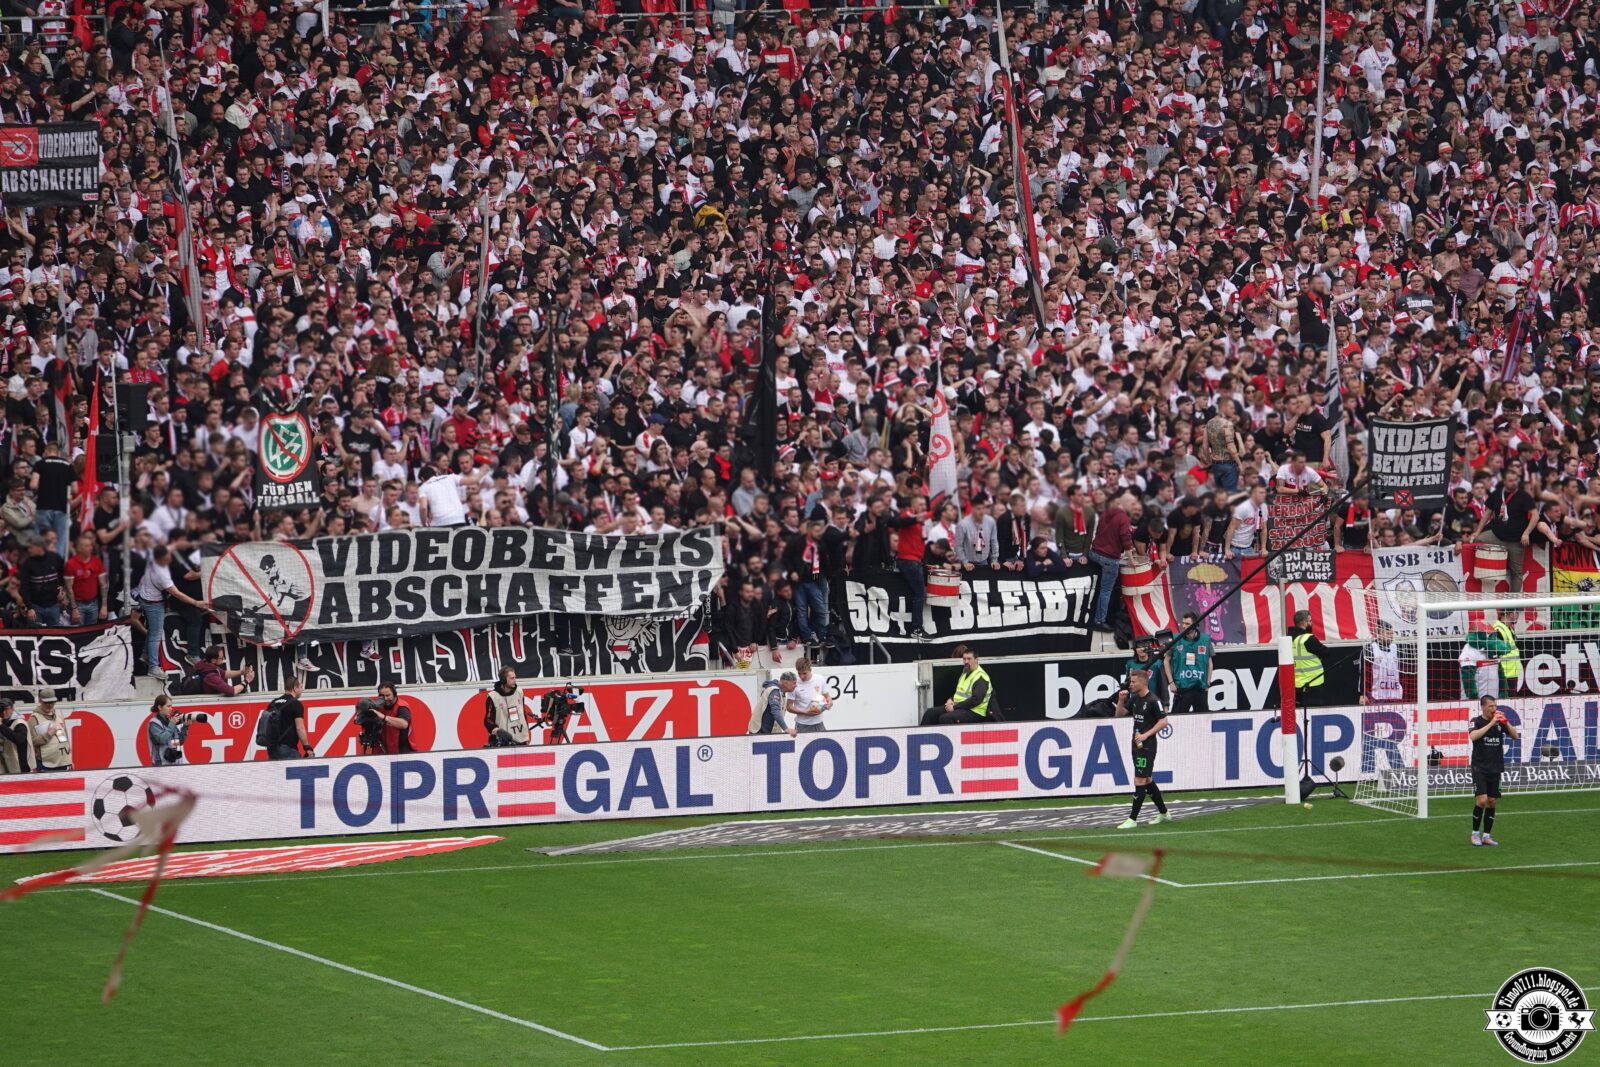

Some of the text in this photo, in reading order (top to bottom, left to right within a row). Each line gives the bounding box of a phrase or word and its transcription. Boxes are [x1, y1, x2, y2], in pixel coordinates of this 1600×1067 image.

[38, 130, 98, 159] VIDEOBEWEIS
[1, 167, 98, 193] ABSCHAFFEN!
[1373, 425, 1448, 453] VIDEO
[1372, 452, 1446, 474] BEWEIS
[262, 480, 313, 496] FÜR DEN
[257, 492, 320, 507] FUSSBALL
[316, 527, 714, 577] VIDEOBEWEIS
[1284, 552, 1331, 562] DU BIST
[1286, 561, 1331, 572] IMMER
[1378, 553, 1420, 569] WSB
[1307, 572, 1333, 580] UNS!
[318, 570, 712, 624] ABSCHAFFEN!
[949, 575, 1098, 630] BLEIBT!
[1180, 669, 1205, 679] HOST
[826, 675, 859, 701] 34
[1044, 663, 1278, 720] beay
[511, 725, 523, 734] TV
[1135, 757, 1147, 768] 30
[1525, 765, 1571, 782] Bank
